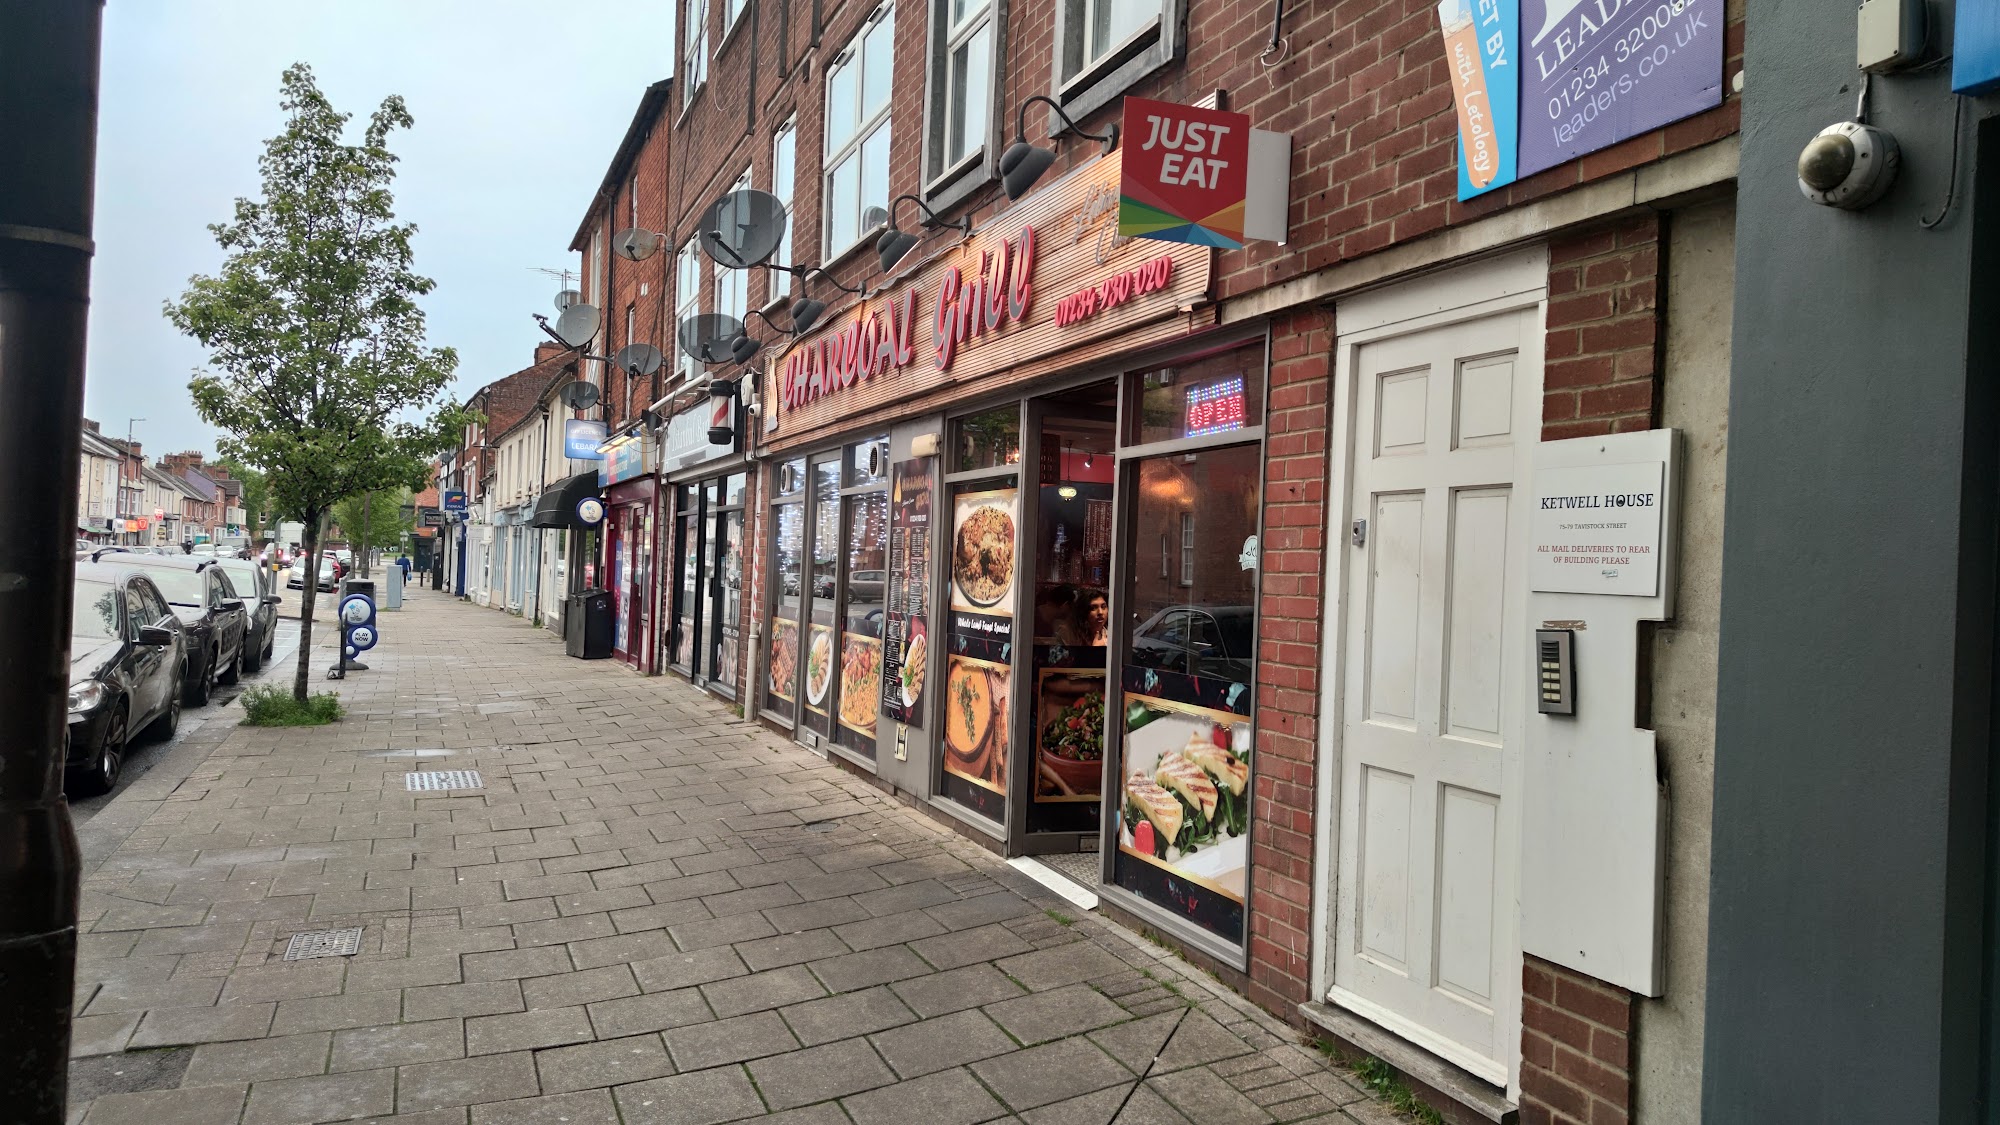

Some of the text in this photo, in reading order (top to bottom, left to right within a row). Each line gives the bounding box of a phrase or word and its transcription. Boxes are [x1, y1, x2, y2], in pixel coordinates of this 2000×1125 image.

[1479, 0, 1507, 69] ET BY
[1534, 0, 1633, 81] LEAD
[1454, 42, 1490, 172] with Letology
[1549, 56, 1610, 119] 01234
[1553, 10, 1708, 147] leaders.co.uk
[1142, 115, 1230, 155] JUST
[1160, 153, 1229, 189] EAT
[782, 288, 915, 411] CHARCOAL
[932, 225, 1035, 371] Grill
[1054, 255, 1173, 328] 01234 930 020
[1189, 395, 1242, 428] OPEN
[1540, 493, 1654, 510] KETWELL HOUSE
[1537, 545, 1651, 554] ALL MAIL DELIVERIES TO REAR
[1553, 556, 1630, 565] OF BUILDING PLEASE
